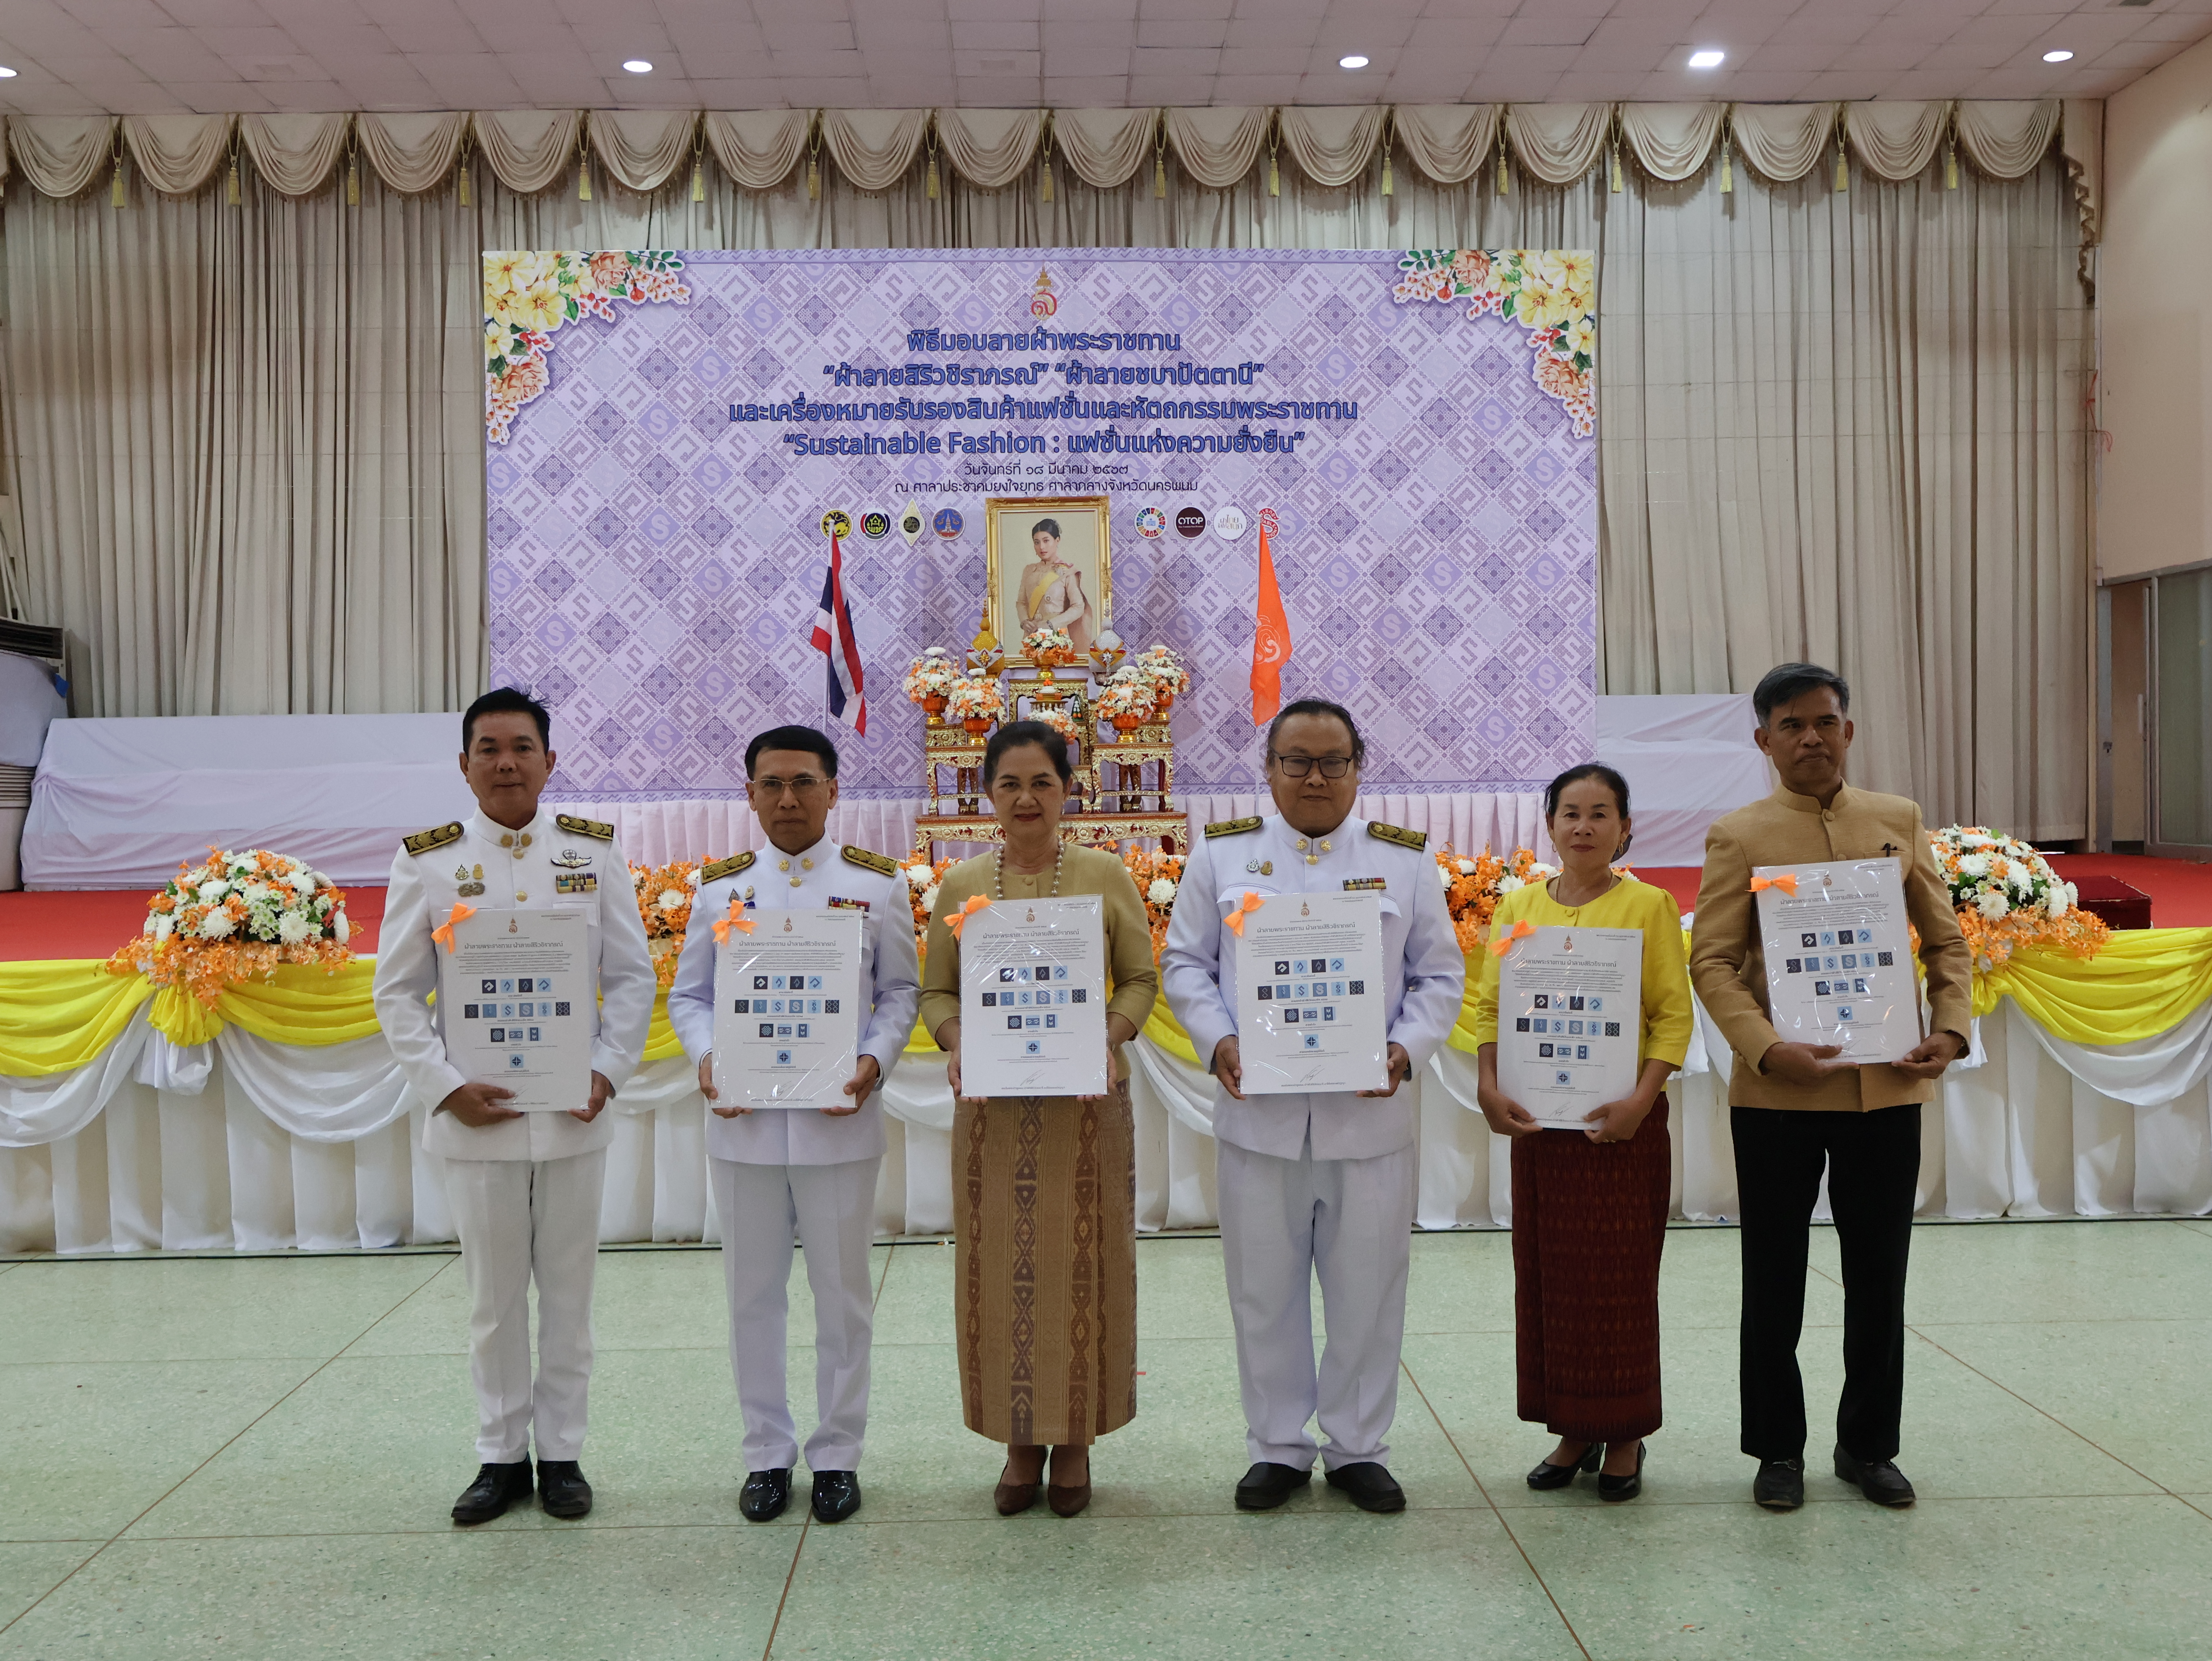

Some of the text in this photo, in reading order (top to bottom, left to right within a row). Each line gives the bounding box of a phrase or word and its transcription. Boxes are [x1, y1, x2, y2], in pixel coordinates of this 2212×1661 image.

[907, 326, 1180, 351] พิธีมอบลายผ้าพระราชทาน
[729, 391, 1358, 421] และเครื่องหมายรับรองสินค้าแฟชั่นและหัตถกรรมพระราชทาน
[783, 431, 940, 455] “Sustainable
[948, 431, 1046, 454] Fashion
[1053, 435, 1060, 453] :
[964, 460, 1128, 475] วันจันทร์ที่ ๑๘ มีนาคม ๒๕๖๗
[895, 478, 1198, 495] ณ ศาลาประชาคมยงใจยุทธ ศาลากลางจังหวัดนครพนม
